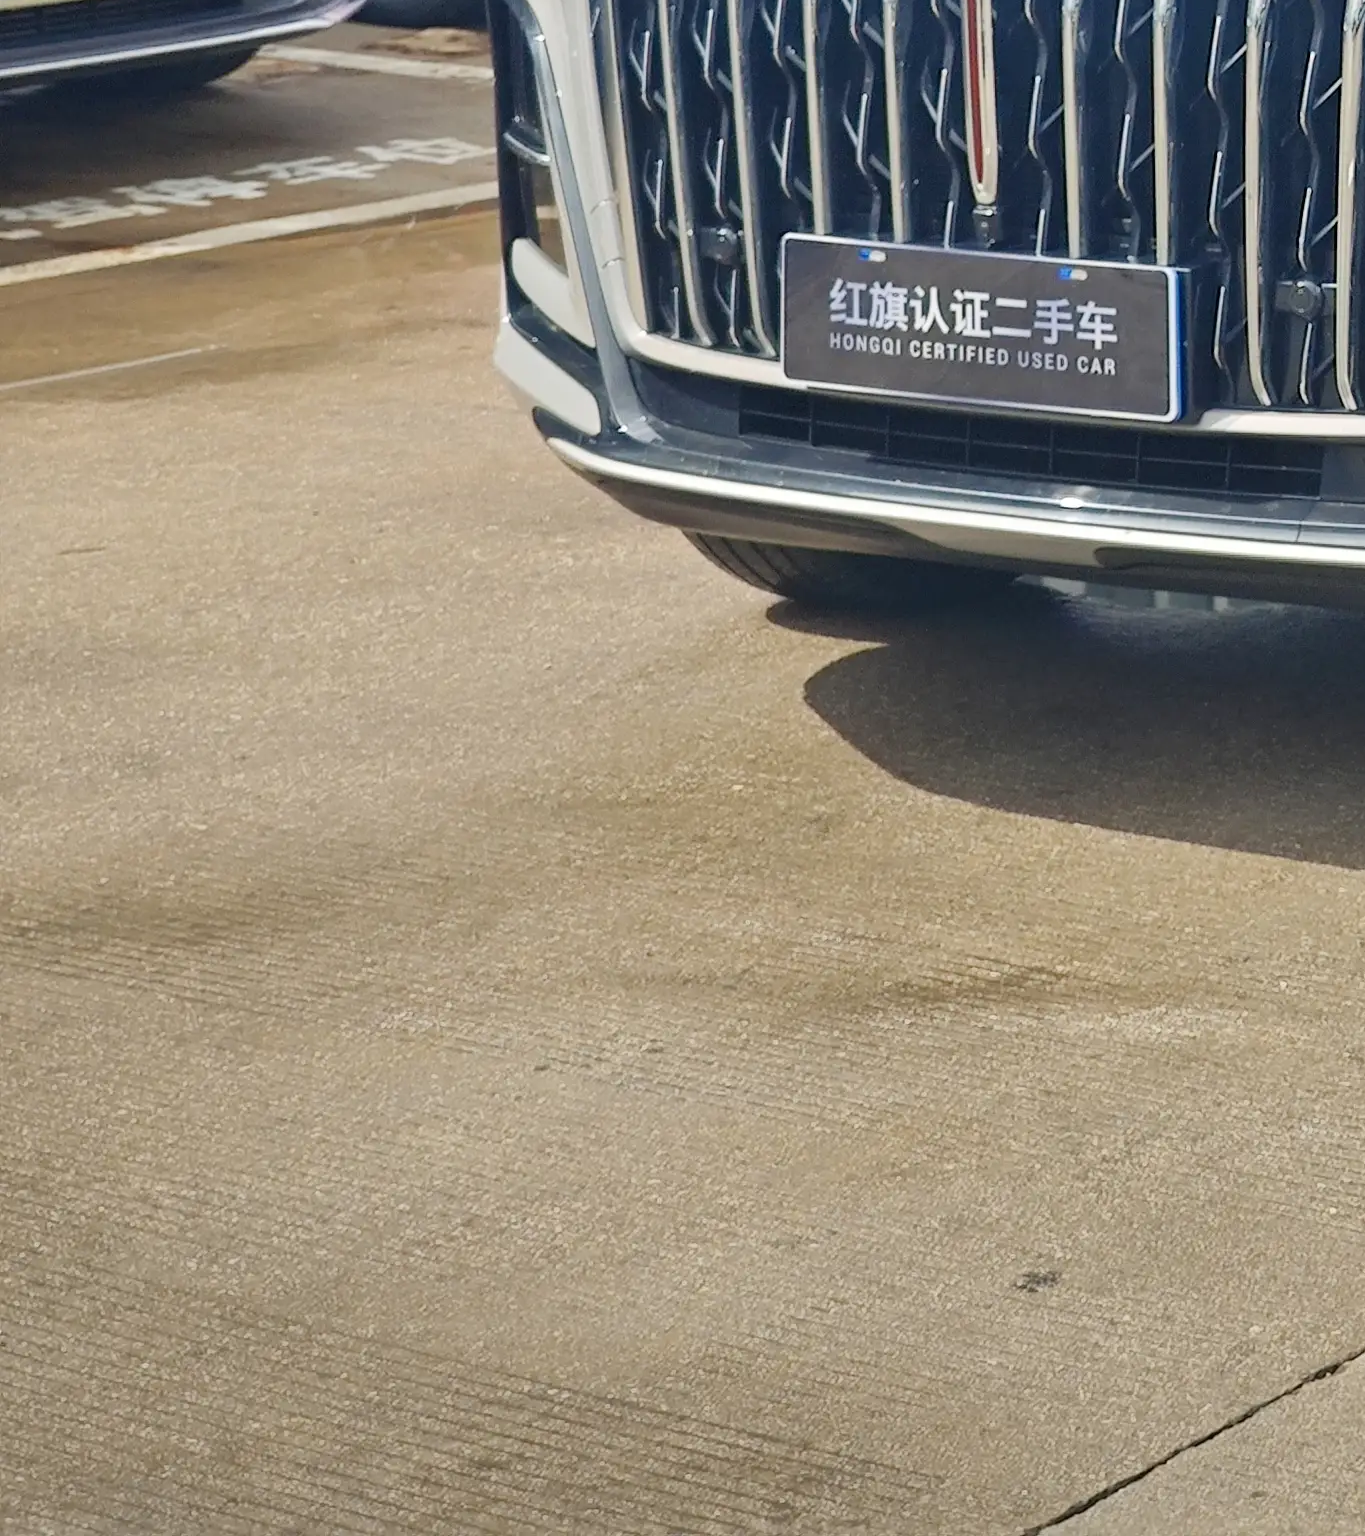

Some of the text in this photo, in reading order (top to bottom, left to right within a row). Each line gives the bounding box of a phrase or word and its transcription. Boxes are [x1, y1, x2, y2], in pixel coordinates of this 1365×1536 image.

[829, 277, 1118, 351] 红旗认证二手车
[829, 331, 1117, 377] HONGQI CERTIFIED USED CAR
